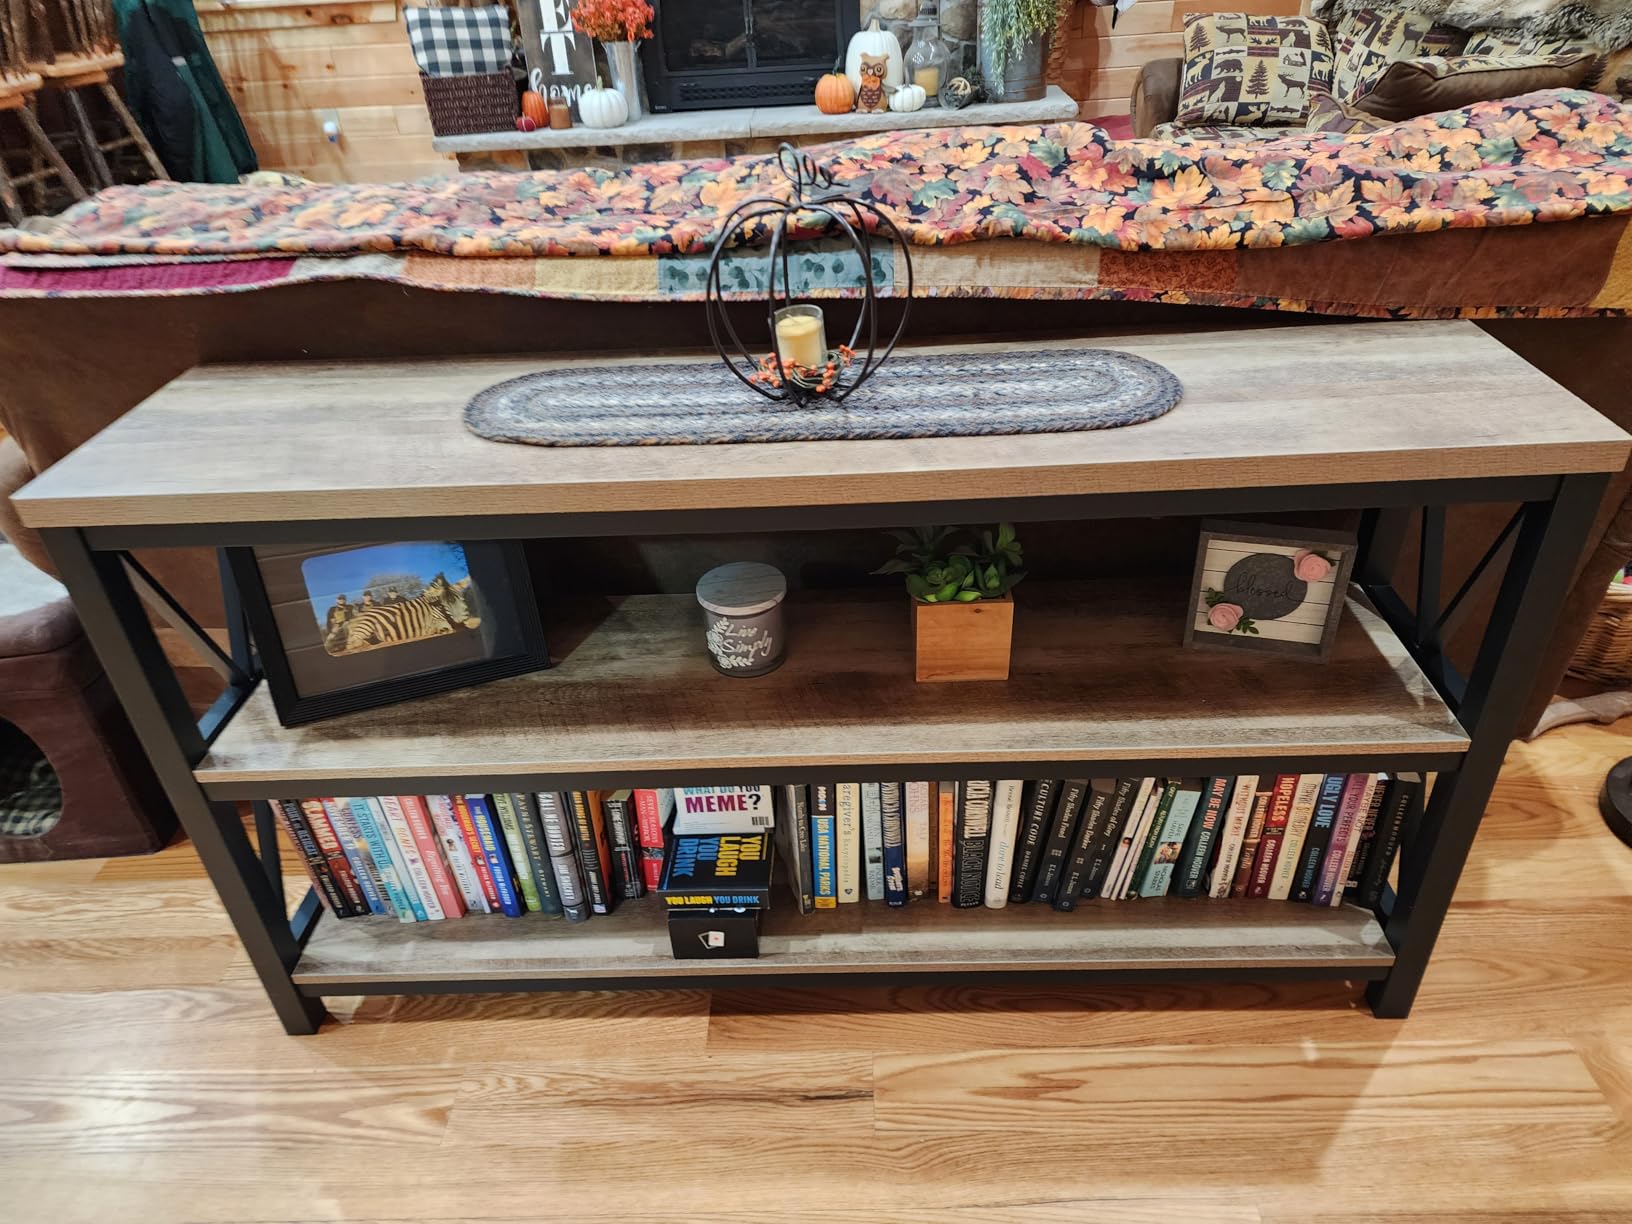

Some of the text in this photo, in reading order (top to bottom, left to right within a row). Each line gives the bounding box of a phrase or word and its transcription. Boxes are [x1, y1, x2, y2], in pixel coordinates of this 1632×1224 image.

[721, 630, 773, 660] Simply
[725, 623, 758, 638] Live
[646, 795, 655, 815] SEVEN
[685, 793, 761, 814] MEME?
[909, 783, 919, 813] OHNS
[1118, 782, 1130, 796] Fifty
[1236, 784, 1250, 813] WITHOUT
[1272, 777, 1293, 821] HOPELESS
[1315, 776, 1342, 827] UGLY LOVE
[1346, 793, 1359, 809] YOUR
[1358, 784, 1374, 813] MAYBE
[839, 784, 854, 834] aregiver's
[964, 800, 987, 837] CORNWELL
[1027, 783, 1049, 844] CULTURE CODE
[1058, 788, 1078, 838] Fifty Shades Freed
[1112, 796, 1125, 815] Shades
[1203, 809, 1216, 829] NOW
[1363, 782, 1384, 830] NEVER NEVER
[357, 813, 375, 838] STARTS
[369, 840, 384, 858] WITH
[474, 815, 495, 850] HOUSEMAID
[516, 794, 540, 859] PAYNE STEWART
[539, 794, 564, 850] CALL ME HUNTER
[1081, 795, 1104, 849] Fifty Shades Darker
[1103, 823, 1115, 836] Grey
[1174, 823, 1183, 836] SAFE
[1336, 811, 1353, 841] PERFECTS
[1354, 815, 1365, 833] NOT
[672, 838, 700, 878] DRINK
[697, 837, 720, 861] YOU
[715, 836, 741, 877] LAUGH
[739, 836, 762, 861] YOU
[818, 835, 830, 870] NATIONAL
[1190, 831, 1210, 878] COLLEEN HOOVER
[1257, 839, 1275, 883] COLLEEN HOOVER
[819, 872, 830, 894] PARKS
[959, 839, 983, 903] BLACK NOTICE
[994, 871, 1005, 889] lead
[1302, 847, 1319, 888] COLLEEN HOOVER
[1323, 849, 1341, 891] COLLEEN HOOVER
[665, 896, 760, 905] YOU LAUGH YOU DRINK
